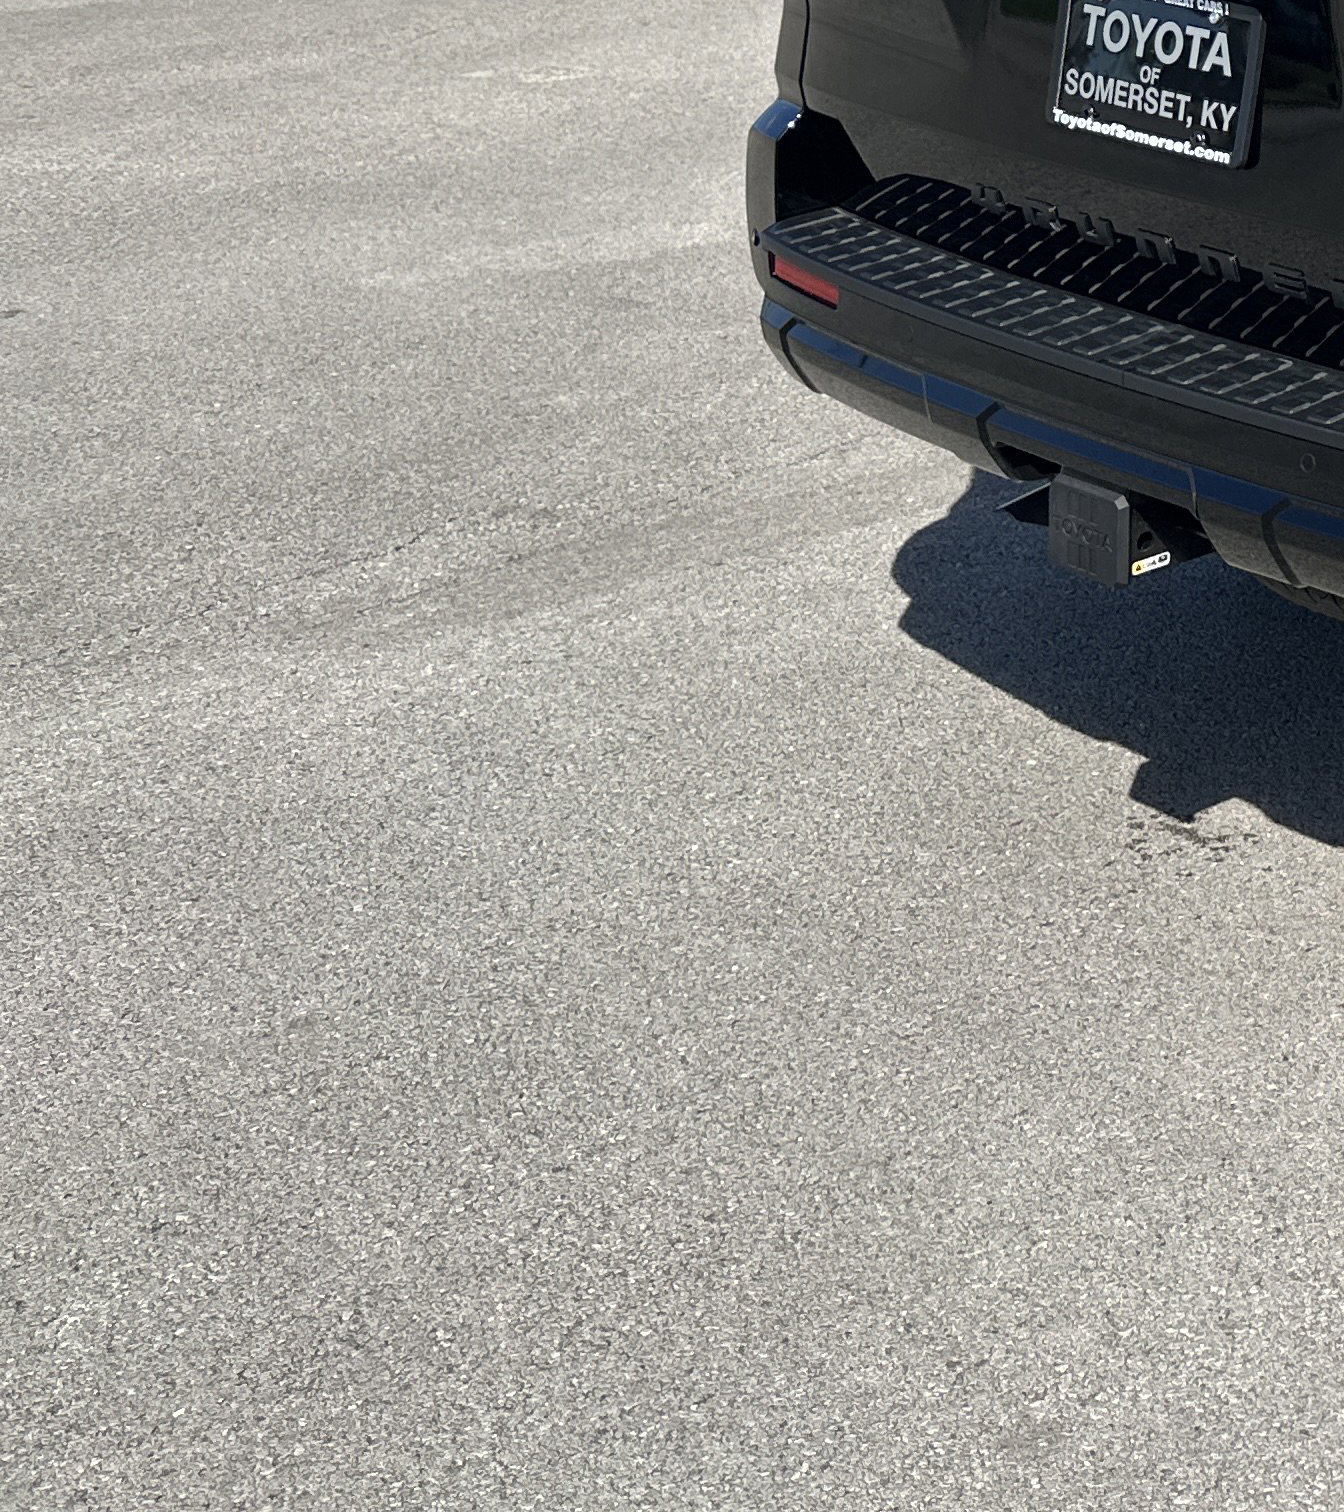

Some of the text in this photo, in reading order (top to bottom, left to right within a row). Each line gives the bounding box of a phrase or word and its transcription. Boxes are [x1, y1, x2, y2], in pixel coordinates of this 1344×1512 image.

[1083, 3, 1232, 77] TOYOTA
[1063, 68, 1237, 132] SOMERSET, KY
[1139, 65, 1161, 85] OF
[1053, 106, 1232, 164] ToyotaofSomerset.com
